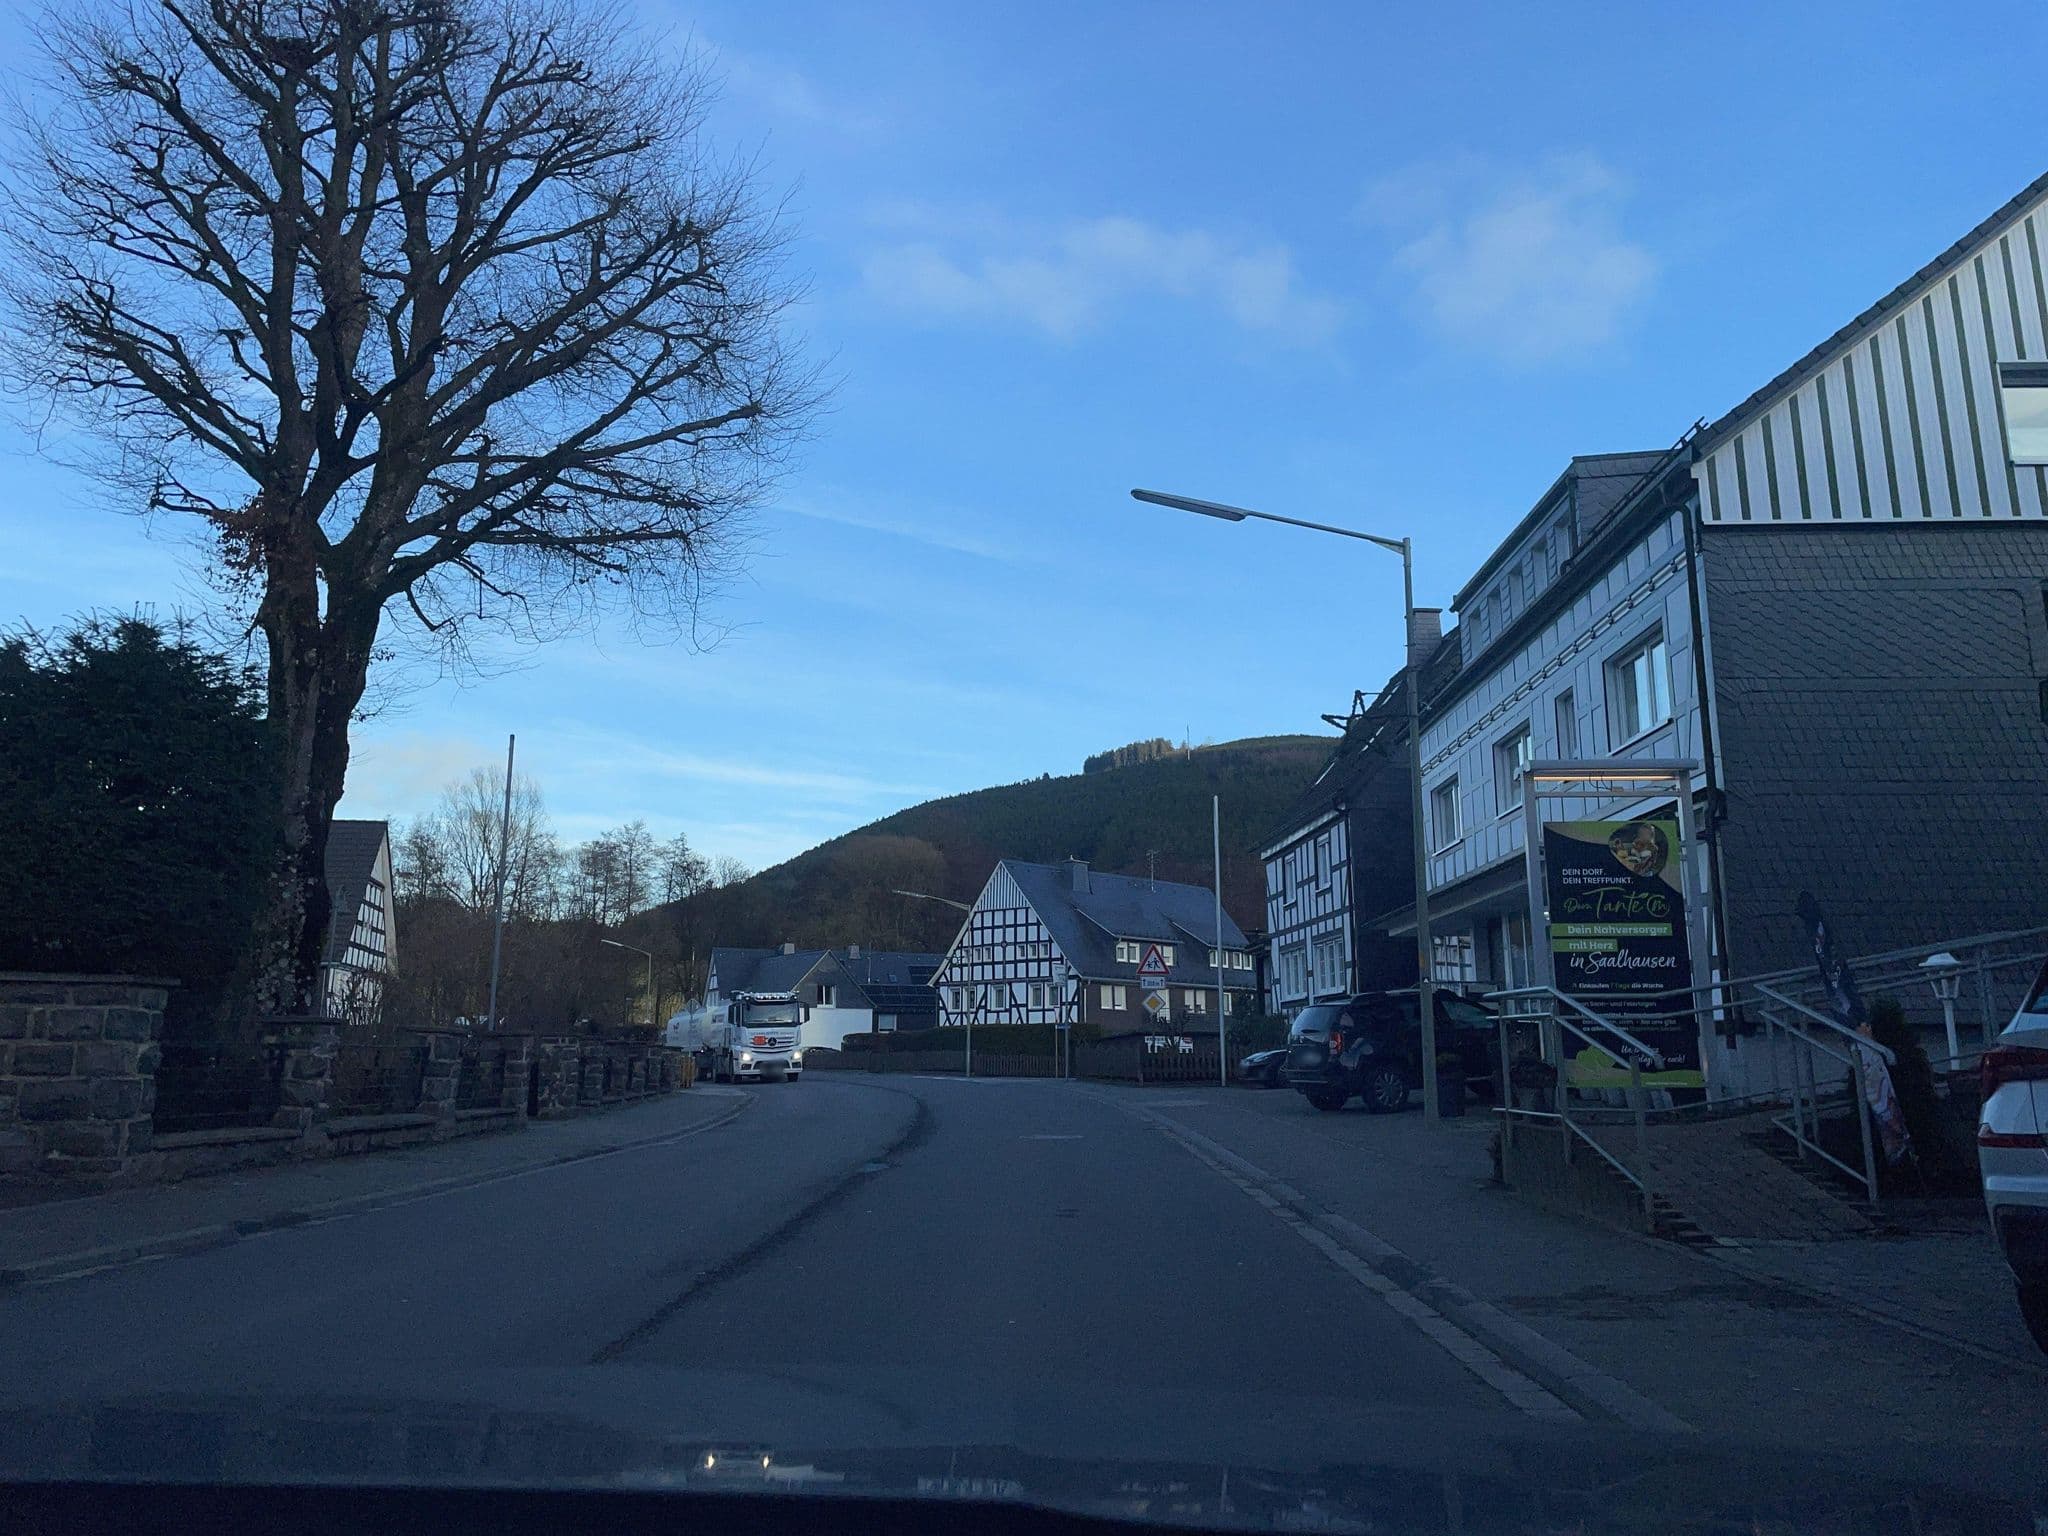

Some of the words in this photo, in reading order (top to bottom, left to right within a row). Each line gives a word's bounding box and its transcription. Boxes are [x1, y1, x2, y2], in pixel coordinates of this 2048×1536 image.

[1568, 926, 1592, 934] Dein
[1594, 926, 1668, 936] Nahversorger
[1569, 942, 1588, 950] mit
[1590, 942, 1614, 950] Herz
[1570, 953, 1584, 968] in
[1584, 948, 1678, 974] Saalhausen
